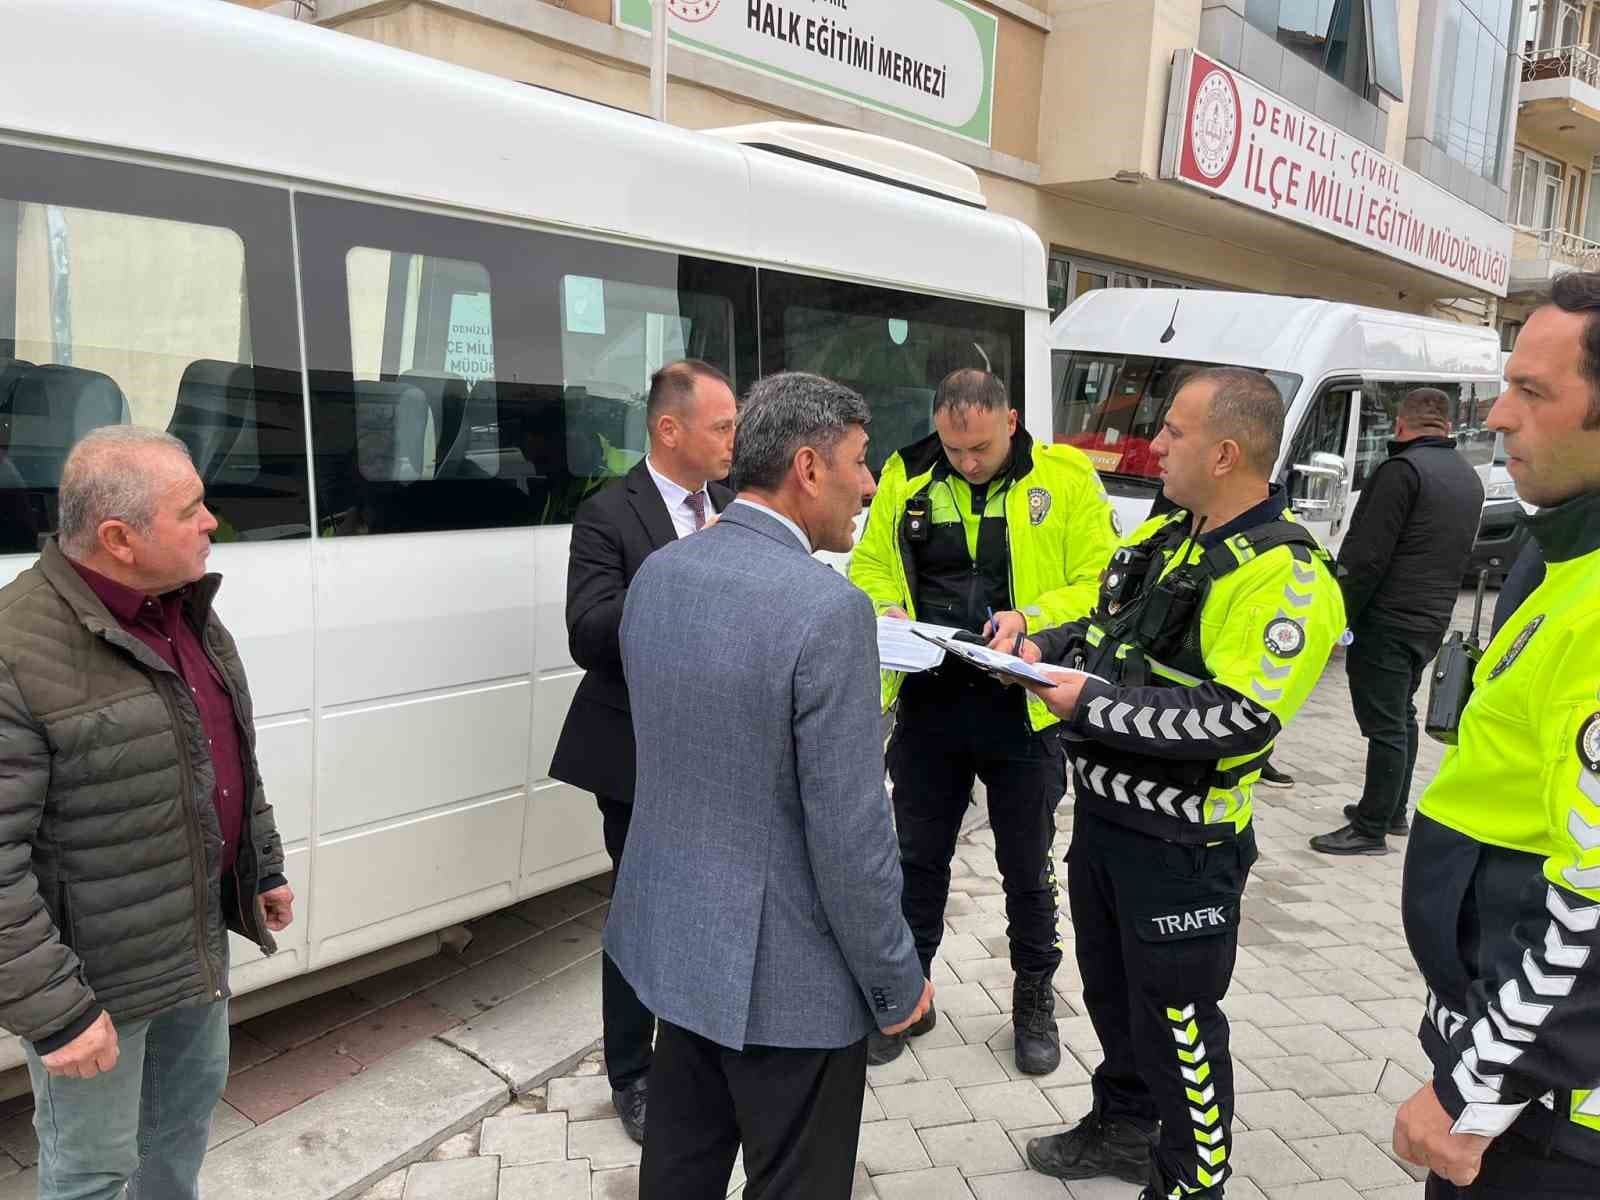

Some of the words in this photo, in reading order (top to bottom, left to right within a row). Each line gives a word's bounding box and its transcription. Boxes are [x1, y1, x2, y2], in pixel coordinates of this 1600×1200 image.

[747, 0, 801, 47] HALK
[805, 16, 875, 73] EĞİTİMİ
[878, 46, 946, 99] MERKEZİ
[1252, 98, 1337, 161] DENİZLİ
[1351, 149, 1400, 194] ÇİVRİL
[1244, 133, 1302, 209] İLÇE
[1305, 170, 1366, 230] MİLLİ
[1366, 196, 1425, 257] EĞİTİM
[1425, 226, 1507, 286] MÜDÜRLÜĞÜ
